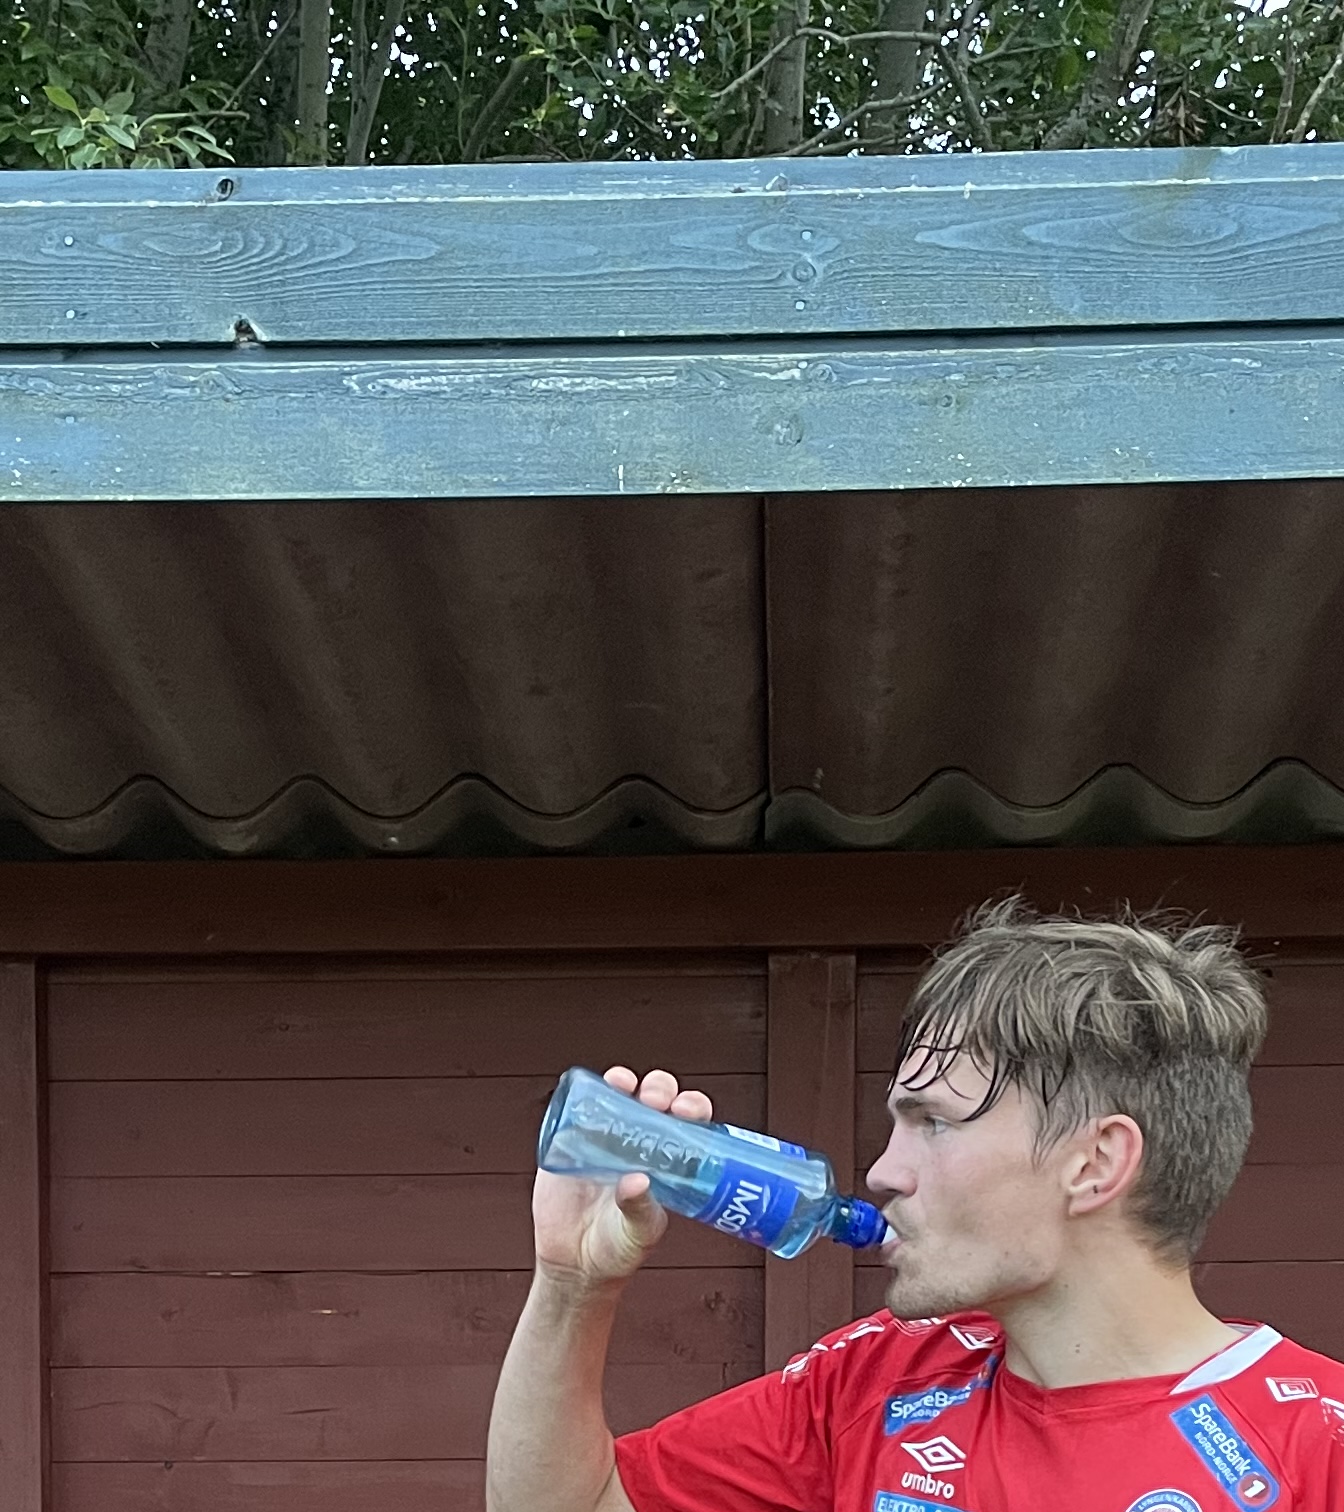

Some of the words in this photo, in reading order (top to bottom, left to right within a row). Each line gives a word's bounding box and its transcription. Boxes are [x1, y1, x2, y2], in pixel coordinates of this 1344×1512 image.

[1190, 1402, 1252, 1476] SpareBank
[1243, 1479, 1266, 1498] 1
[901, 1471, 955, 1499] umbro
